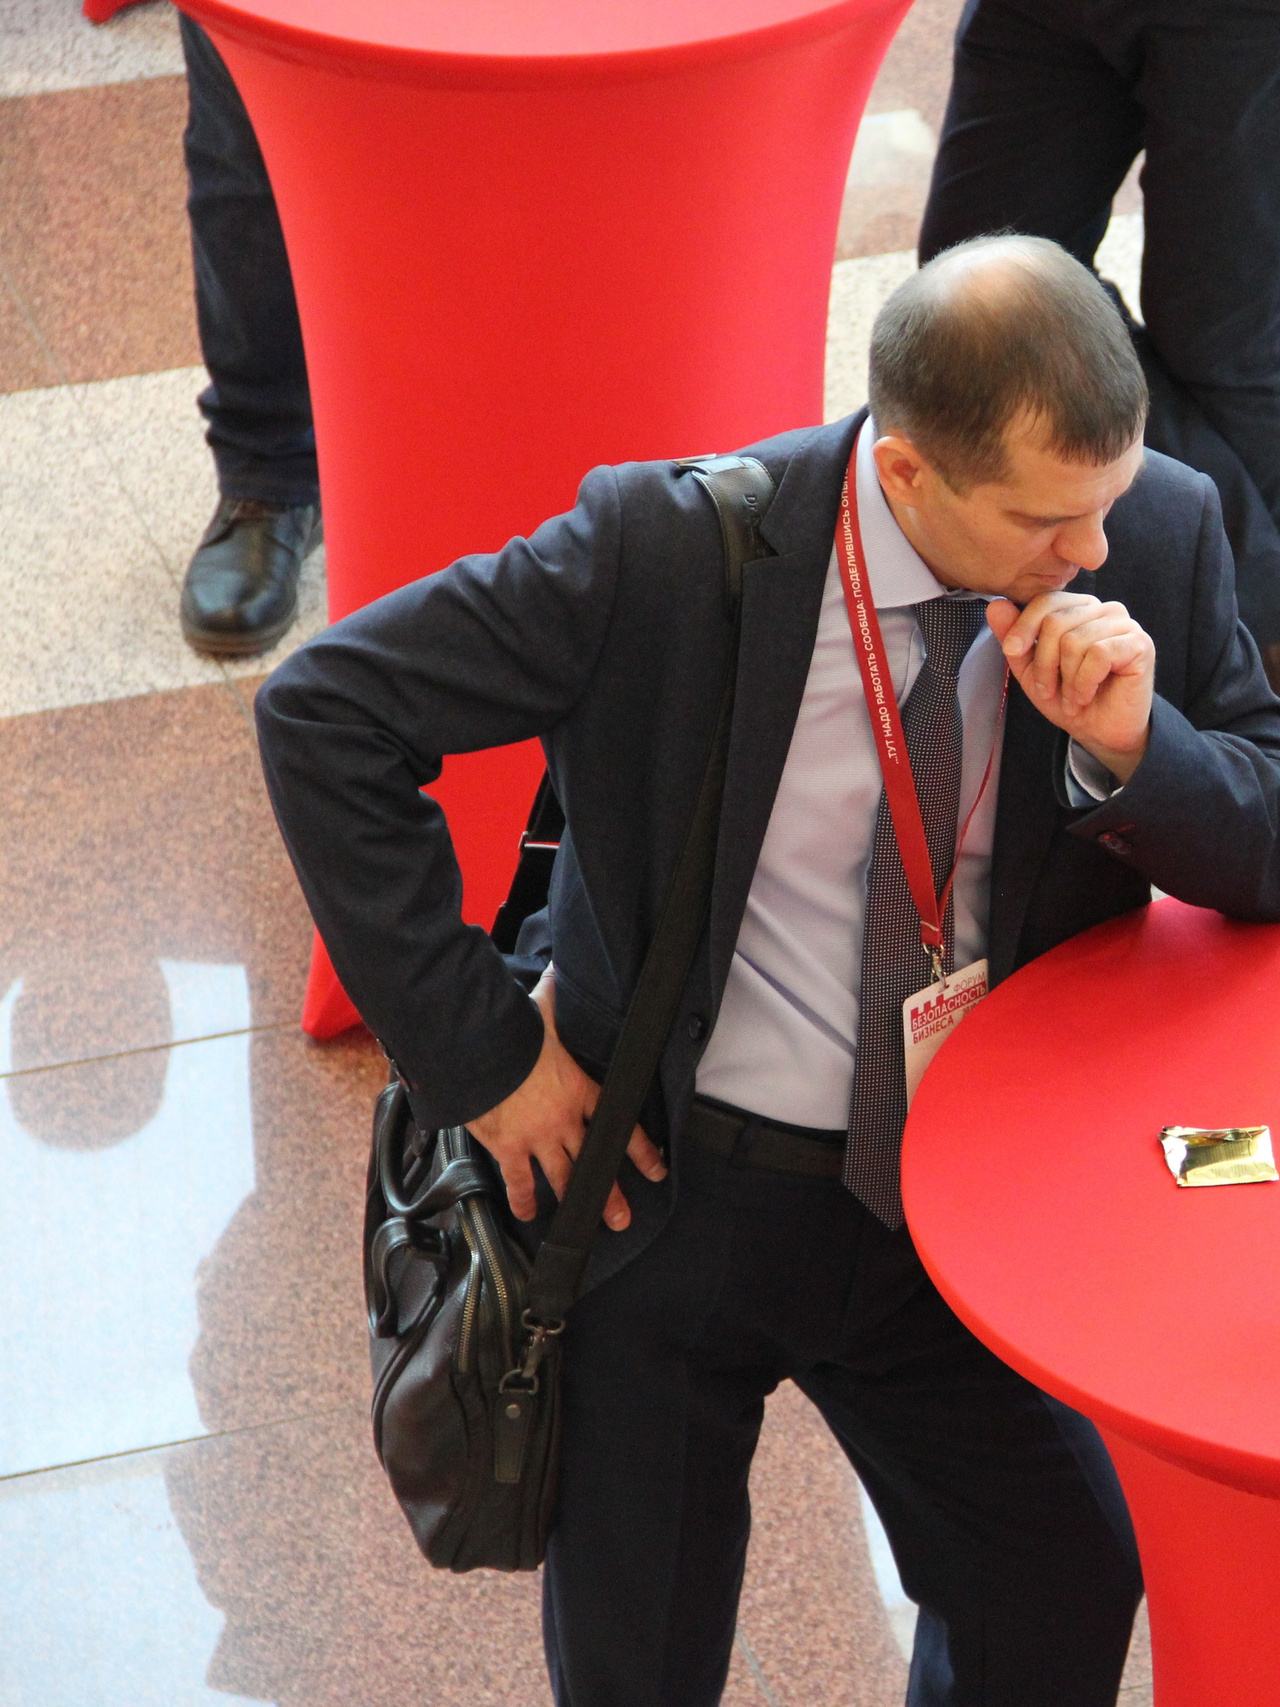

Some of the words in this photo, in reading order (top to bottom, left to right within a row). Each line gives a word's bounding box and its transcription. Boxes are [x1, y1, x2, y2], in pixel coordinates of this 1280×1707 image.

[842, 509, 862, 598] ПОДЕЛИВШИСЬ
[856, 599, 873, 651] СООБЩА:
[867, 652, 886, 704] РАБОТАТЬ
[878, 705, 893, 737] НАДО
[954, 972, 985, 992] ФОРУМ
[912, 984, 986, 1030] БЕЗОПАСНОСТЬ
[913, 1015, 955, 1045] БИЗНЕСА
